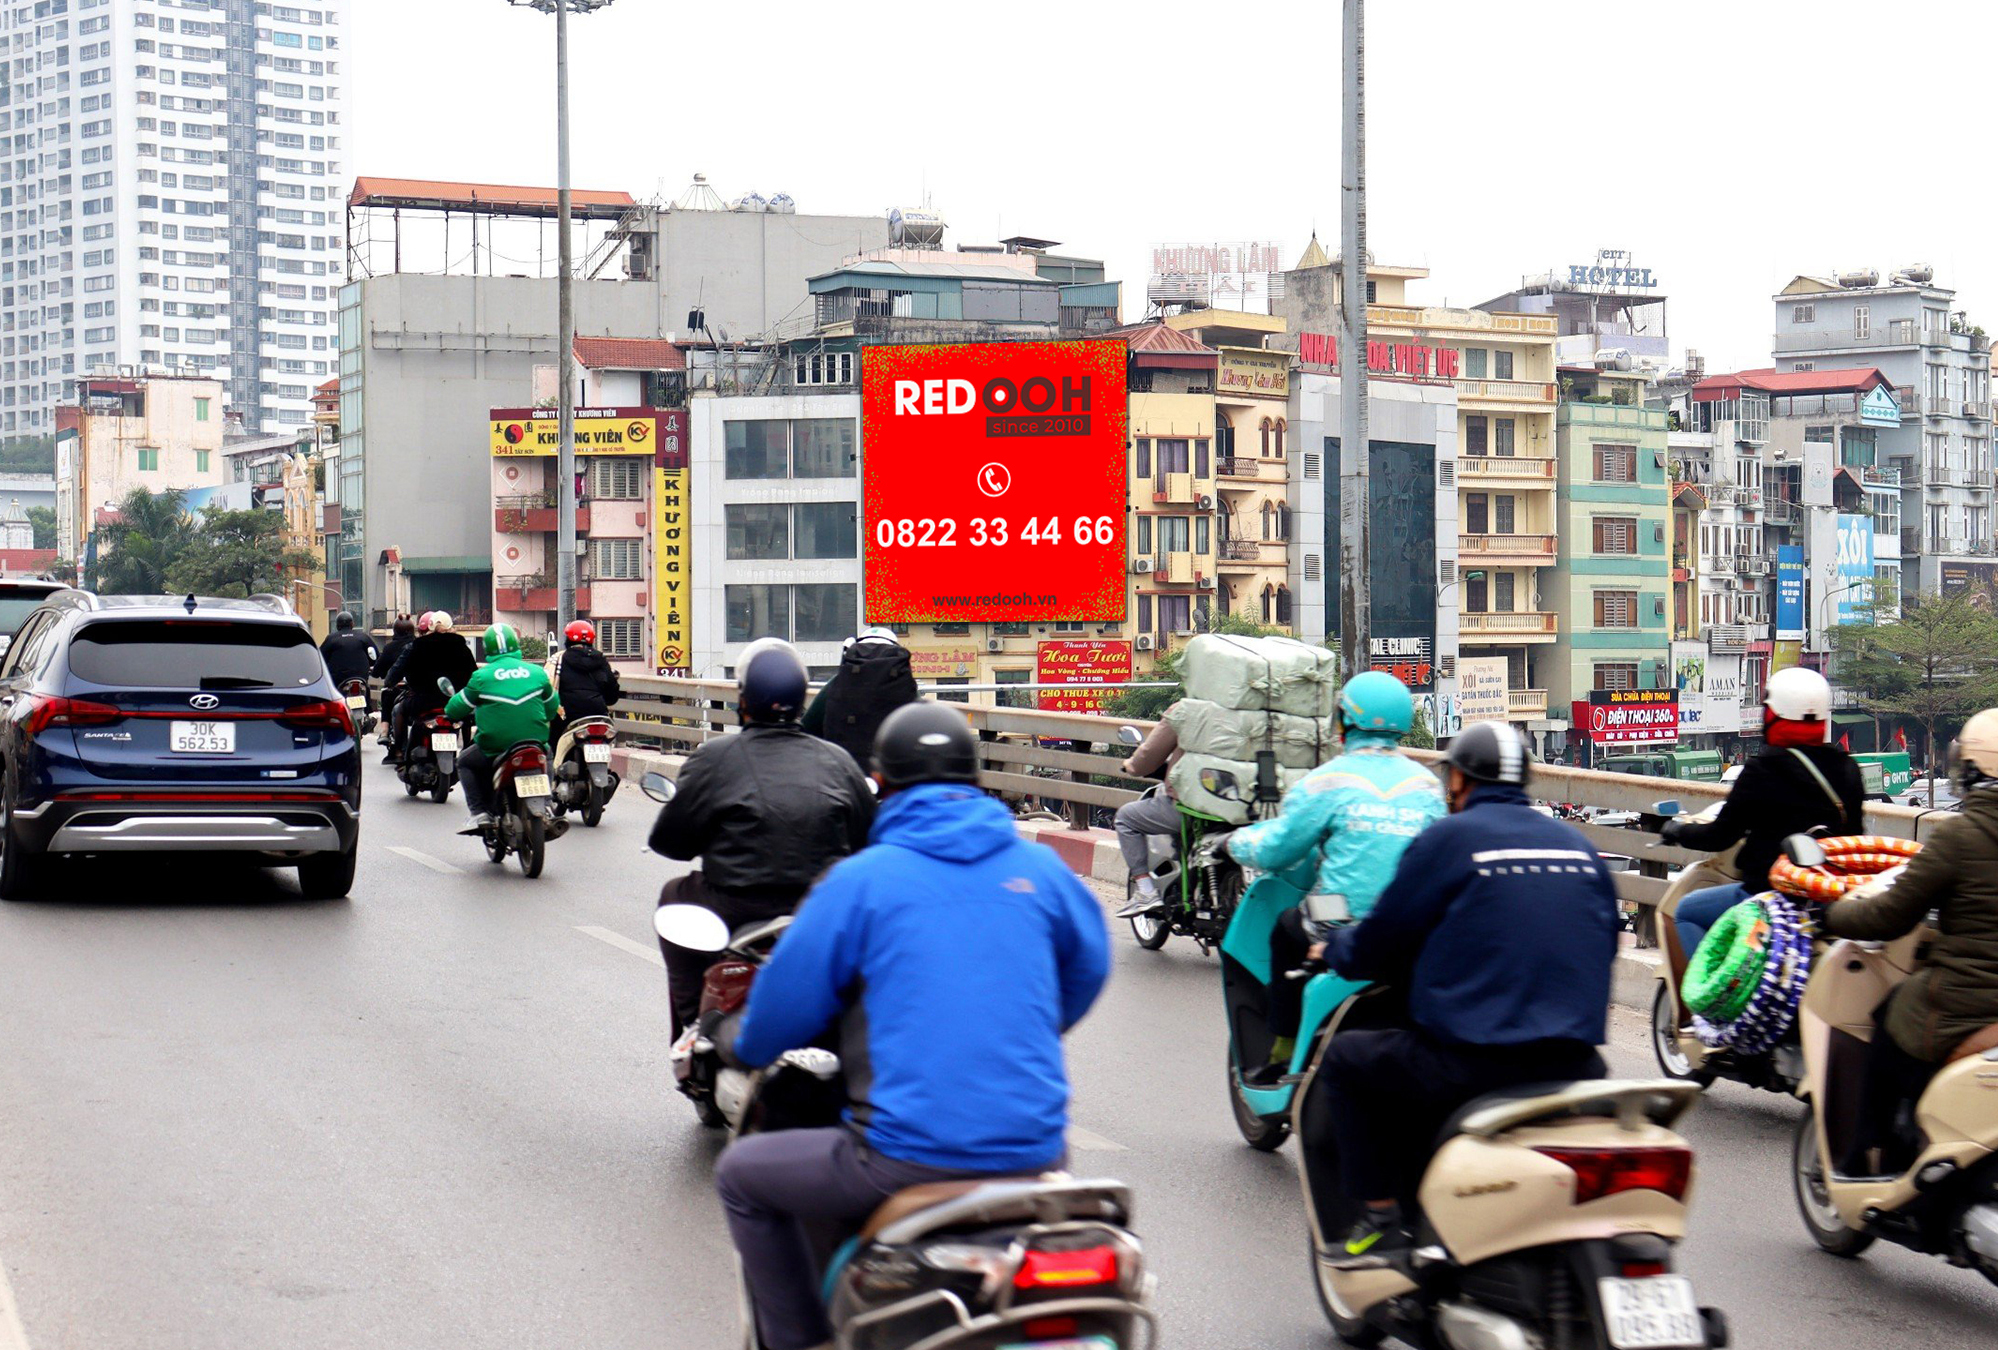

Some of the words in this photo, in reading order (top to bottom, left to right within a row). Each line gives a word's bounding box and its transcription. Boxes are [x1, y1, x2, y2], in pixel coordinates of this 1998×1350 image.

[1237, 241, 1278, 273] LÂM
[1602, 249, 1625, 259] err
[1568, 265, 1657, 287] HOTEL
[1368, 341, 1390, 371] OA
[1394, 336, 1432, 382] VIỆT
[895, 379, 976, 416] RED
[982, 376, 1091, 414] OOH
[993, 419, 1038, 433] since
[1044, 418, 1083, 433] 2010
[537, 431, 591, 444] KHNG
[594, 429, 622, 443] VIÊN
[495, 445, 514, 454] 341
[664, 479, 682, 573] KHƯƠNG
[876, 518, 957, 547] 0822
[969, 517, 1008, 546] 33
[1021, 516, 1062, 545] 44
[1074, 516, 1114, 545] 66
[1837, 518, 1867, 564] XÔI
[932, 592, 1057, 606] www.redooh.vn
[666, 581, 682, 642] VIÊN
[1388, 637, 1420, 655] CLINIC
[942, 649, 975, 662] LÂM
[1043, 649, 1079, 663] Hoa
[1086, 649, 1128, 663] Tươi
[494, 667, 530, 680] Grab
[1058, 667, 1076, 675] Vòng
[1462, 672, 1476, 688] XÔI
[1709, 677, 1735, 690] AMAN
[1041, 690, 1060, 698] CHO
[1641, 690, 1653, 703] ĐIỆN
[1654, 692, 1670, 703] THOẠI
[1608, 707, 1627, 728] ĐIỆN
[1628, 709, 1654, 726] THOẠI
[190, 723, 216, 736] 30K
[178, 737, 228, 750] 562.53
[1891, 771, 1909, 784] GHTK
